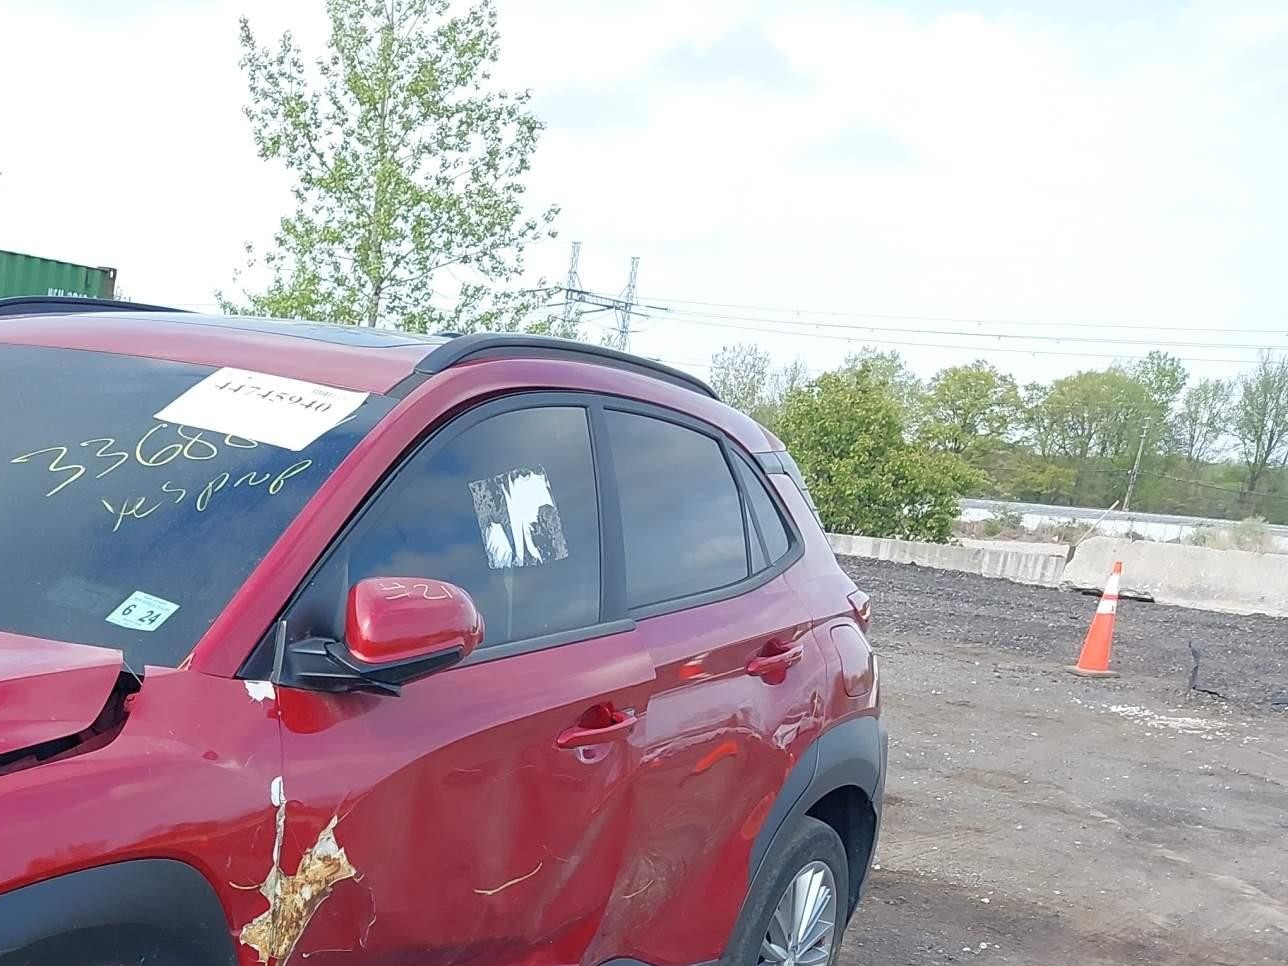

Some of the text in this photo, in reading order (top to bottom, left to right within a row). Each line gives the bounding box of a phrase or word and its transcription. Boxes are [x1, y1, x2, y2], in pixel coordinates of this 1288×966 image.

[215, 379, 332, 414] 44745940
[122, 604, 136, 616] 6
[139, 610, 161, 625] 24
